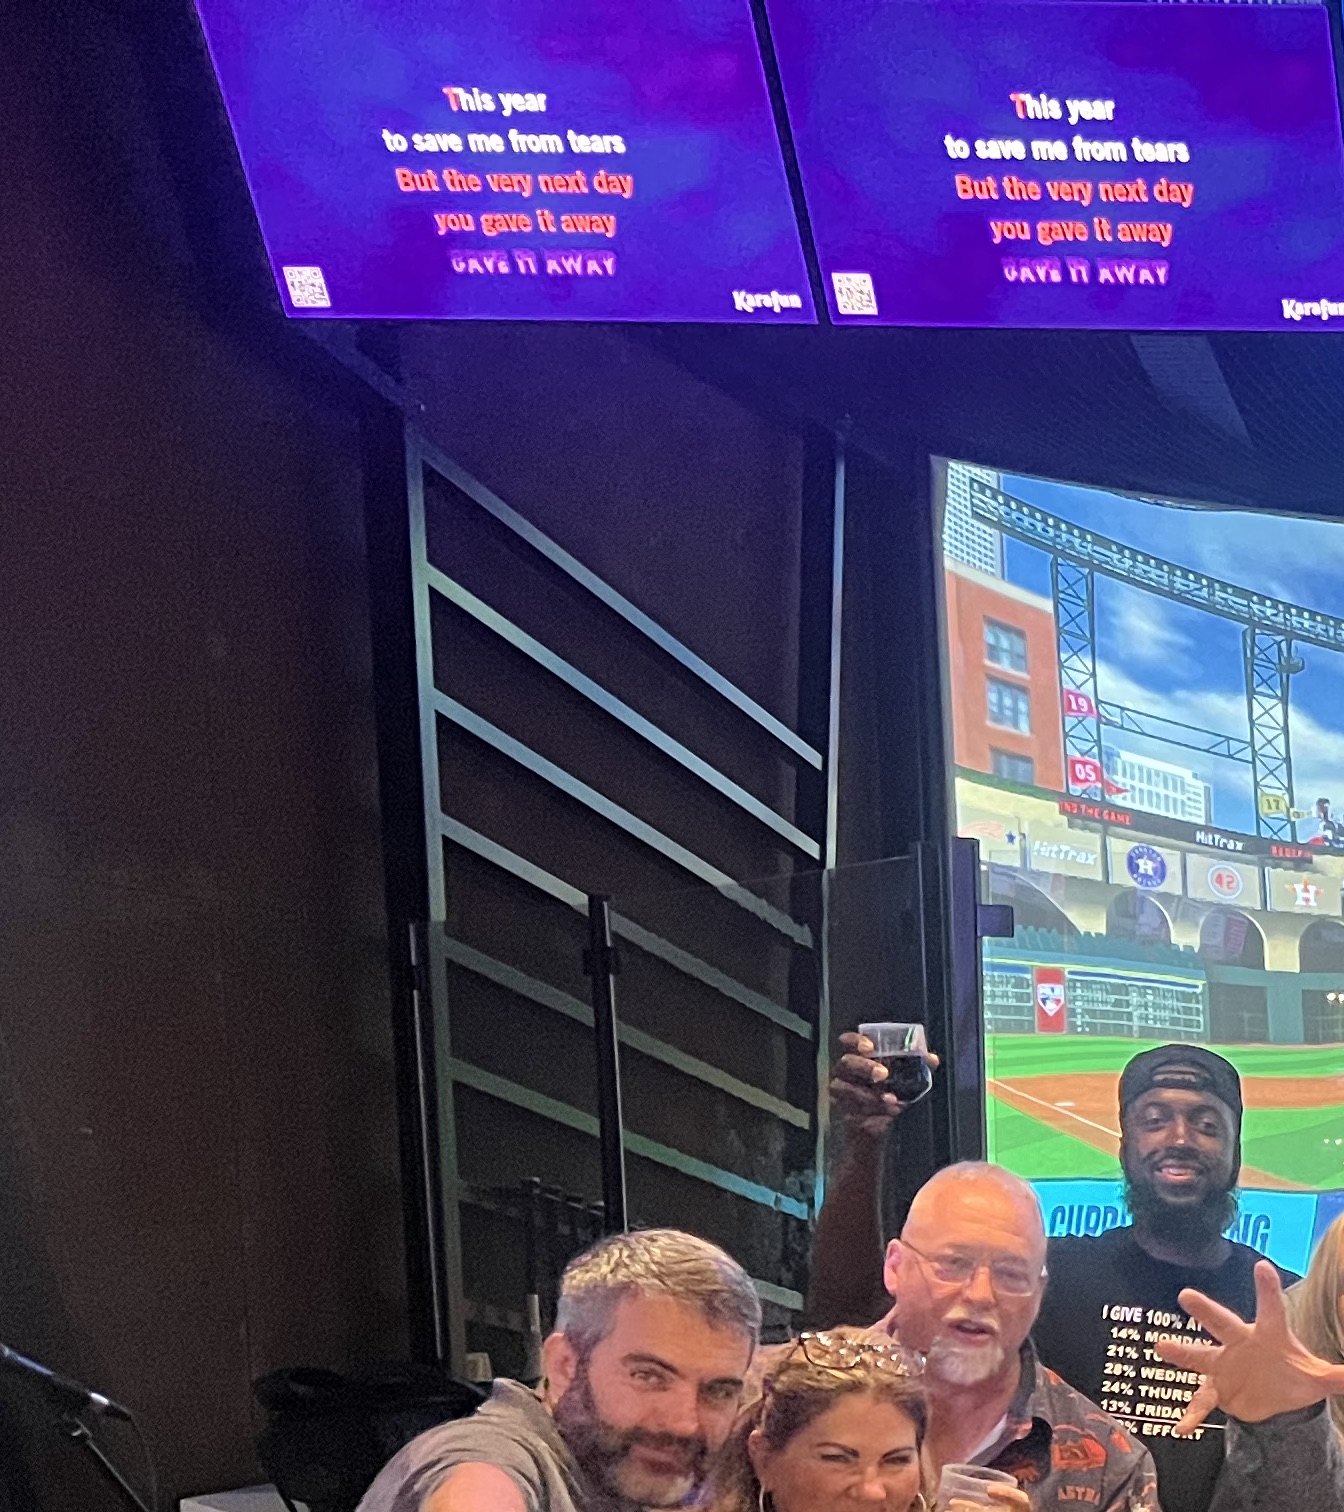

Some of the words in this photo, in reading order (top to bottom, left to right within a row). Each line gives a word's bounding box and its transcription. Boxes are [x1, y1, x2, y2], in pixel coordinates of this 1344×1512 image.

[442, 86, 495, 113] This
[499, 90, 546, 116] year
[1010, 93, 1062, 120] This
[1067, 96, 1115, 124] year
[382, 128, 408, 153] to
[412, 131, 463, 153] save
[468, 133, 505, 153] me
[509, 131, 563, 153] from
[567, 131, 626, 155] tears
[944, 135, 970, 159] to
[975, 137, 1026, 160] save
[1031, 138, 1067, 160] me
[1072, 135, 1127, 161] from
[1131, 138, 1190, 162] tears
[396, 168, 440, 191] But
[444, 169, 481, 192] the
[486, 173, 533, 197] very
[539, 171, 589, 195] next
[593, 173, 633, 198] day
[955, 175, 998, 199] But
[1002, 176, 1041, 200] the
[1046, 180, 1092, 206] very
[1098, 178, 1148, 202] next
[1154, 179, 1194, 207] day
[435, 211, 475, 235] you
[481, 212, 531, 236] gave
[536, 209, 556, 232] it
[561, 214, 616, 237] away
[990, 219, 1031, 243] you
[1037, 221, 1088, 246] gave
[1093, 217, 1112, 242] it
[1117, 221, 1173, 246] away
[1068, 693, 1089, 712] 19
[1265, 799, 1280, 811] 17
[1102, 1305, 1109, 1319] I
[1110, 1306, 1142, 1322] GIVE
[1146, 1310, 1182, 1329] 100%
[1111, 1327, 1140, 1341] 14%
[1106, 1344, 1138, 1360] 21%
[1103, 1363, 1136, 1378] 28%
[1141, 1367, 1207, 1384] WEDNES
[1101, 1381, 1134, 1396] 24%
[1138, 1385, 1193, 1402] THURS
[1101, 1399, 1131, 1414] 13%
